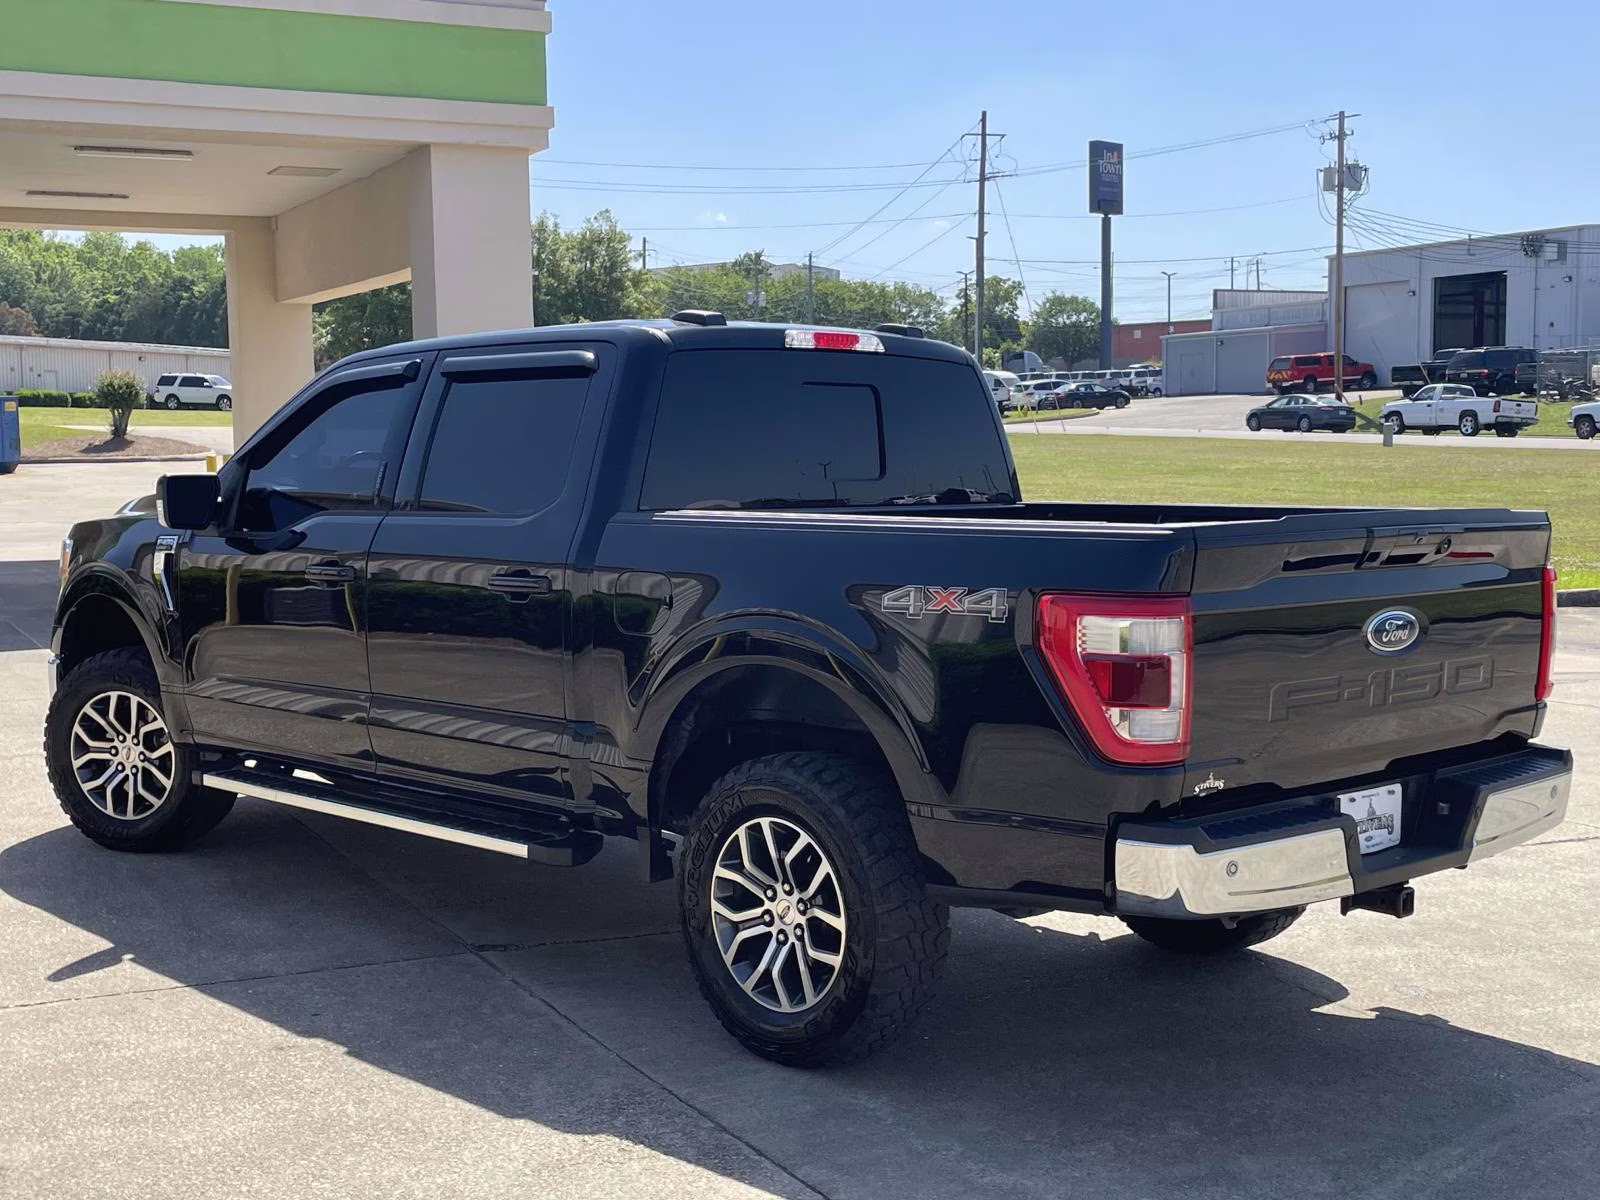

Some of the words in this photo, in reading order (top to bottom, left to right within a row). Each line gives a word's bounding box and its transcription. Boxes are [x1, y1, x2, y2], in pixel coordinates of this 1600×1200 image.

[1103, 149, 1113, 162] In
[1382, 619, 1410, 642] Ford
[1269, 654, 1495, 722] F-150
